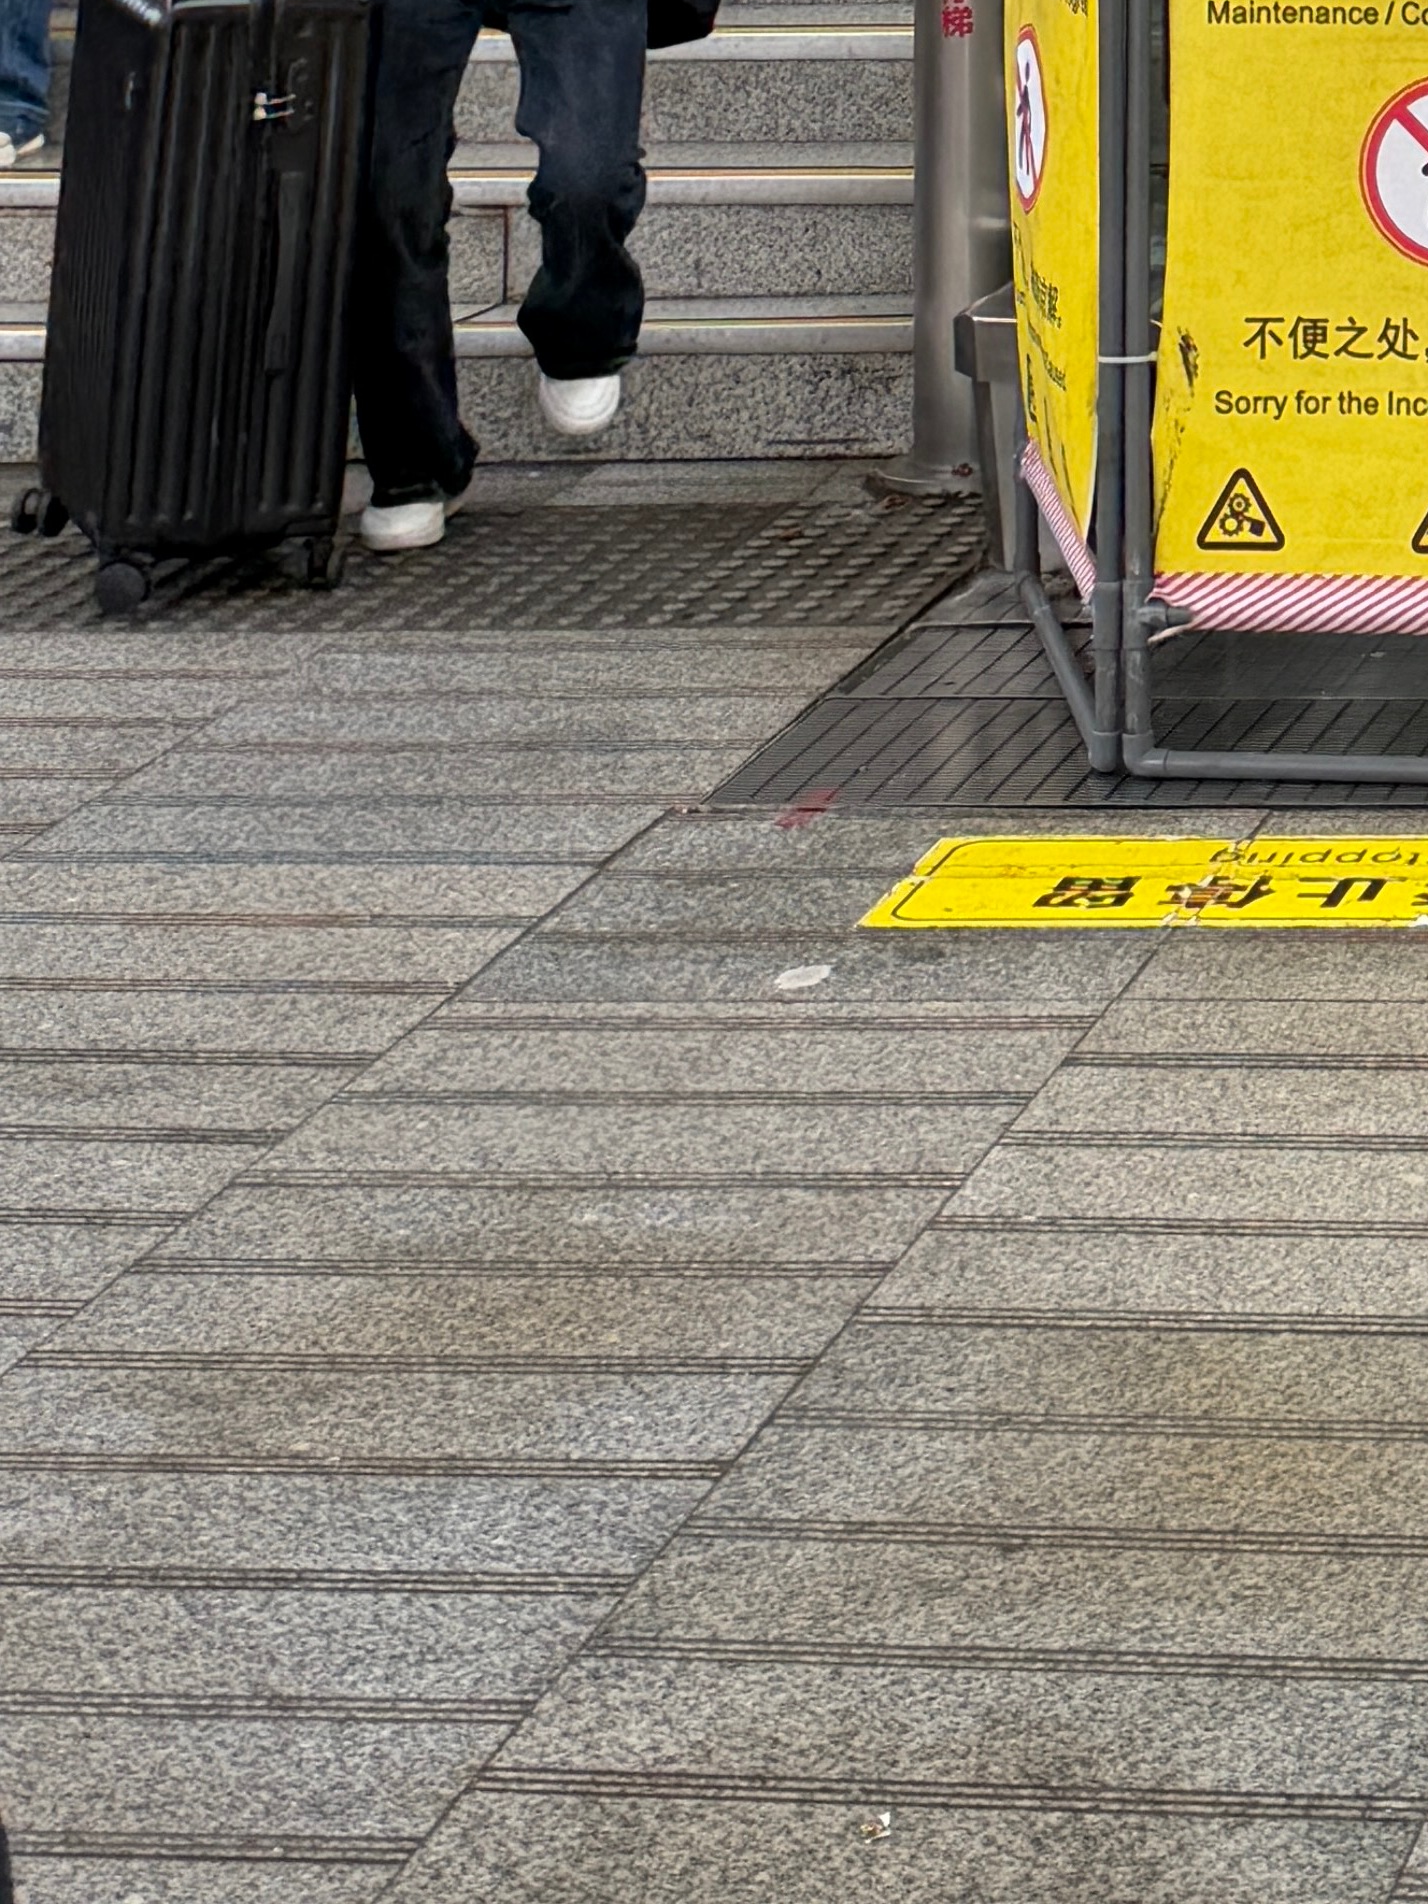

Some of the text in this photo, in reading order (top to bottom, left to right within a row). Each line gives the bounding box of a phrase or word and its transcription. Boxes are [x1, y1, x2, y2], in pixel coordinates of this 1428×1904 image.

[1207, 0, 1378, 26] Maintenance
[1214, 390, 1287, 420] Sorry
[1295, 391, 1332, 416] for
[1338, 391, 1379, 416] the
